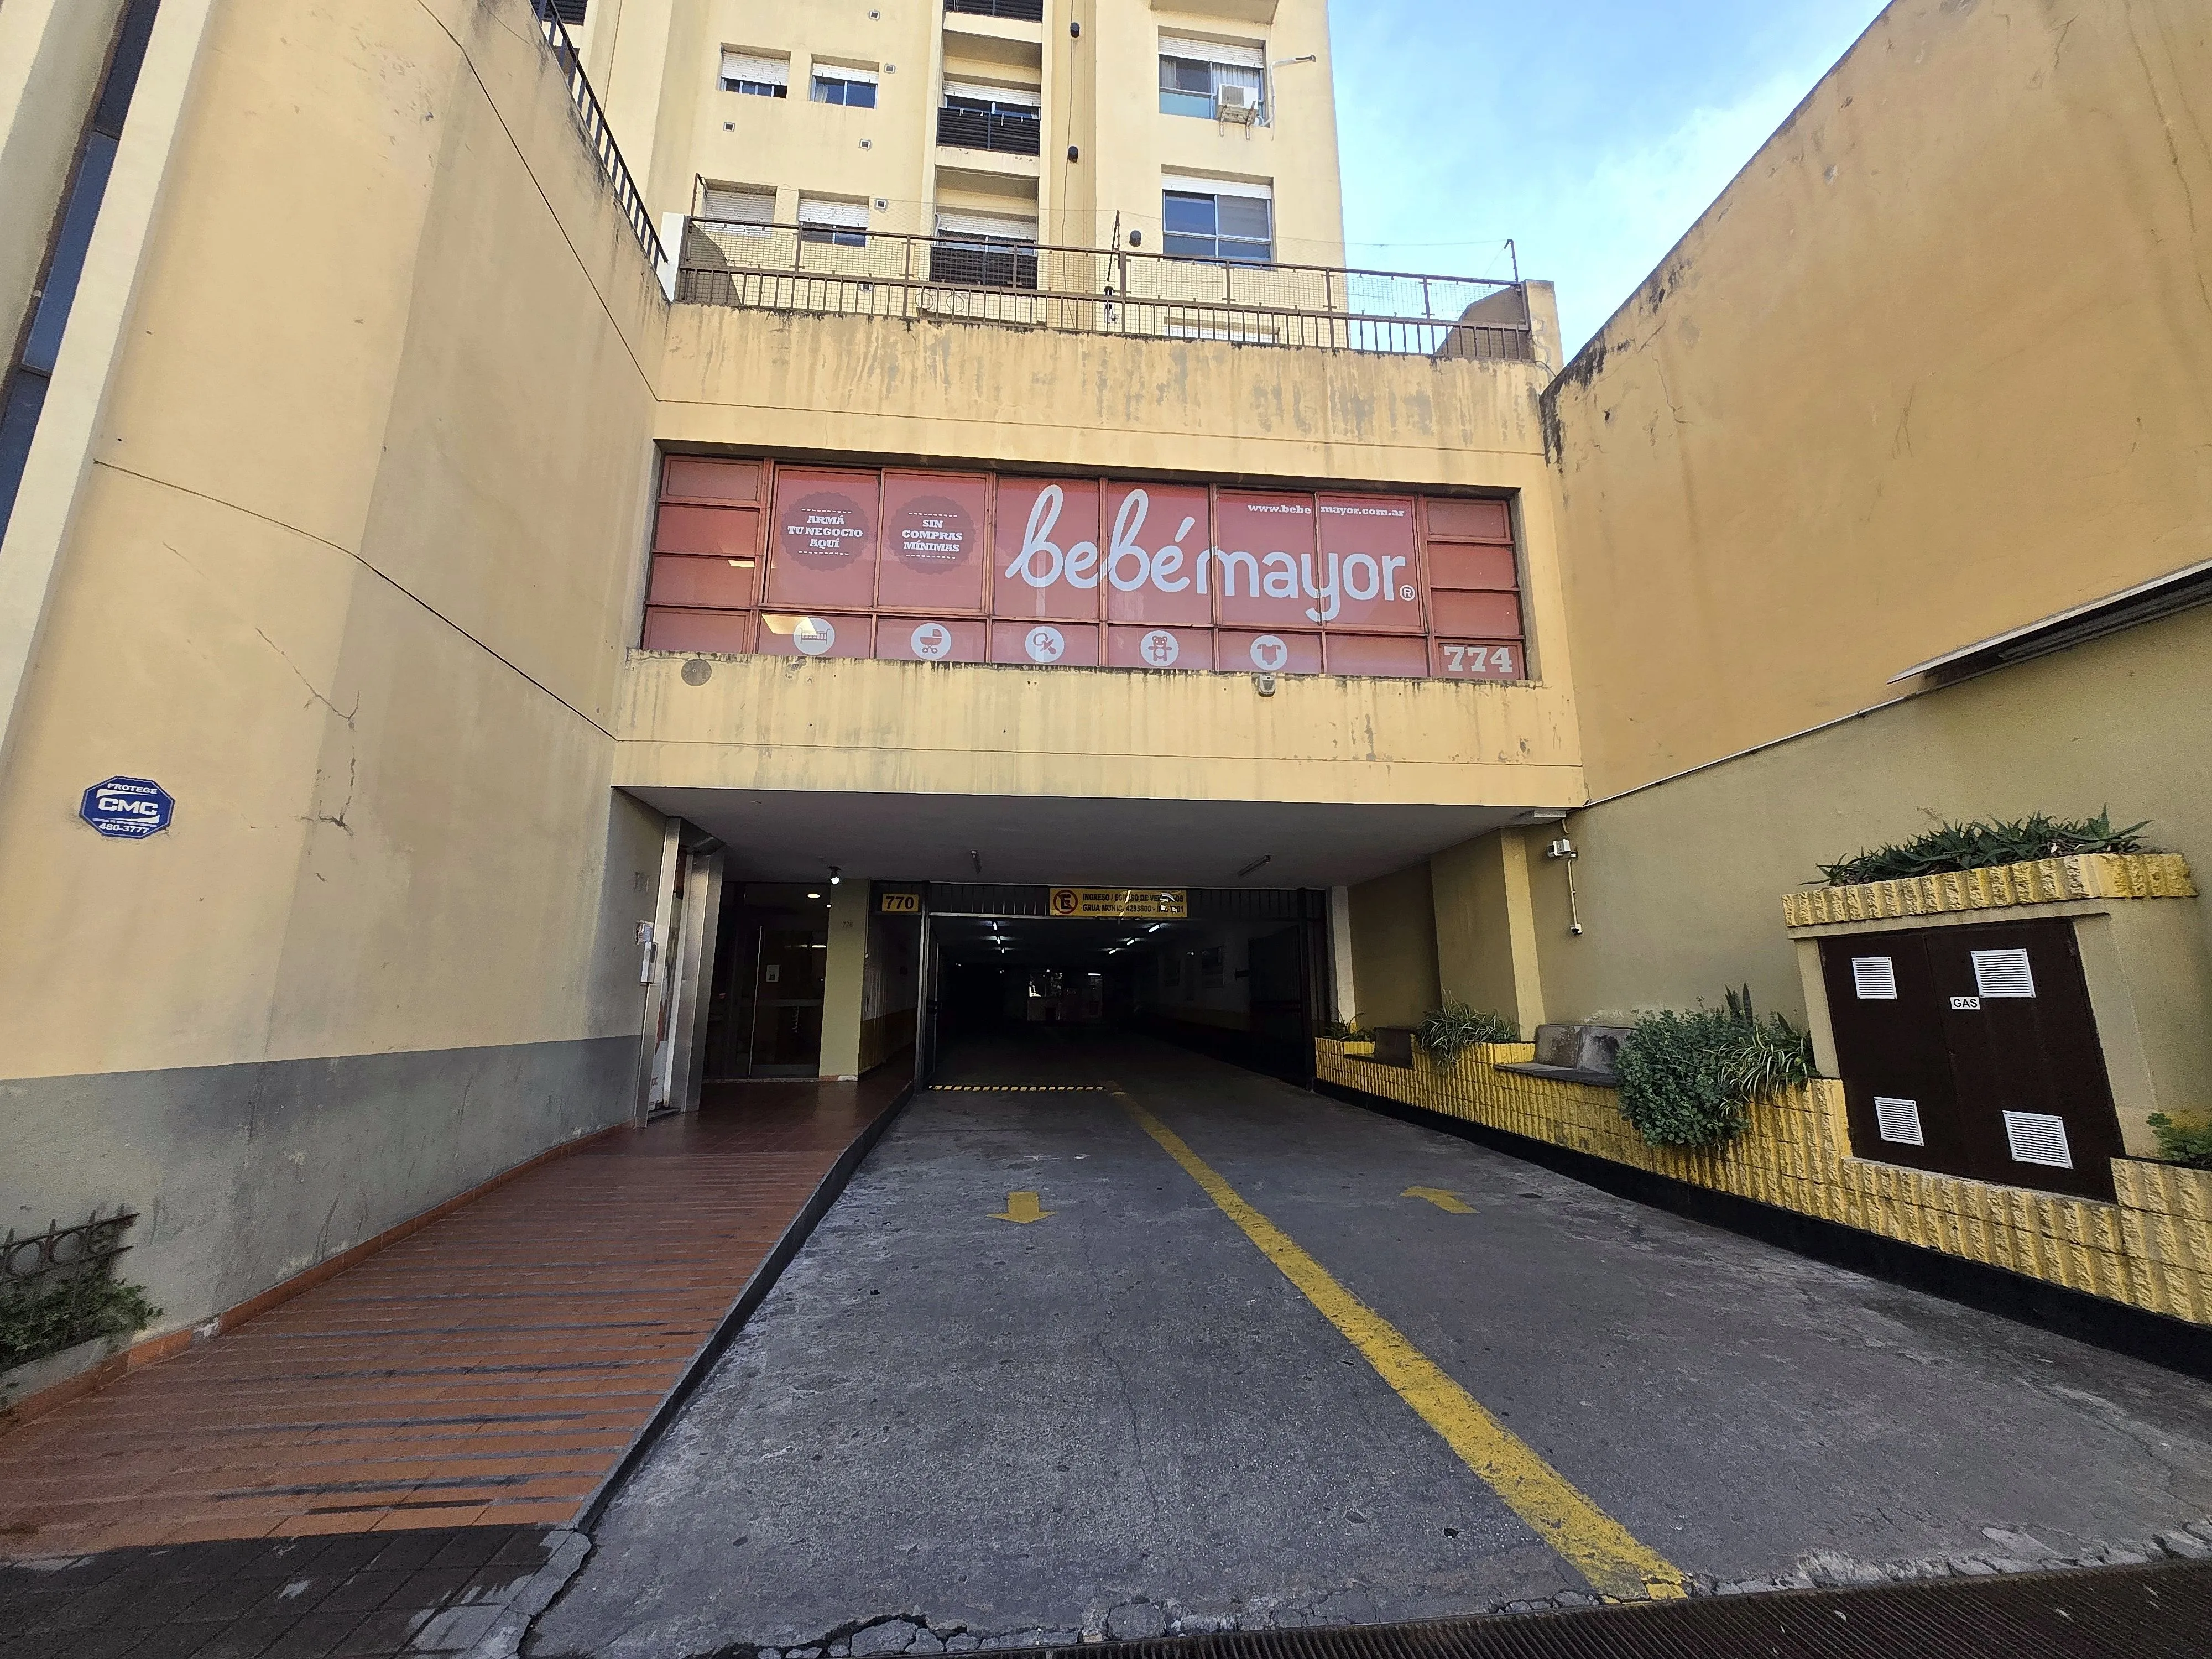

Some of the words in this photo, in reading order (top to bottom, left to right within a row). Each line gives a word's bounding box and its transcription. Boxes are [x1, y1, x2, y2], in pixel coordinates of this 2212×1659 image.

[807, 515, 844, 525] ARMÁ
[922, 520, 943, 528] SIN
[787, 526, 804, 535] TU
[805, 527, 863, 537] NEGOCIO
[902, 530, 962, 540] COMPRAS
[810, 538, 839, 549] AQUÍ
[904, 540, 959, 552] MÍNIMAS
[1444, 646, 1512, 672] 774
[107, 783, 158, 794] PROTEGE
[98, 798, 158, 815] CMC
[99, 823, 149, 833] 480-3777
[886, 896, 914, 909] 770
[1954, 999, 1978, 1008] GAS
